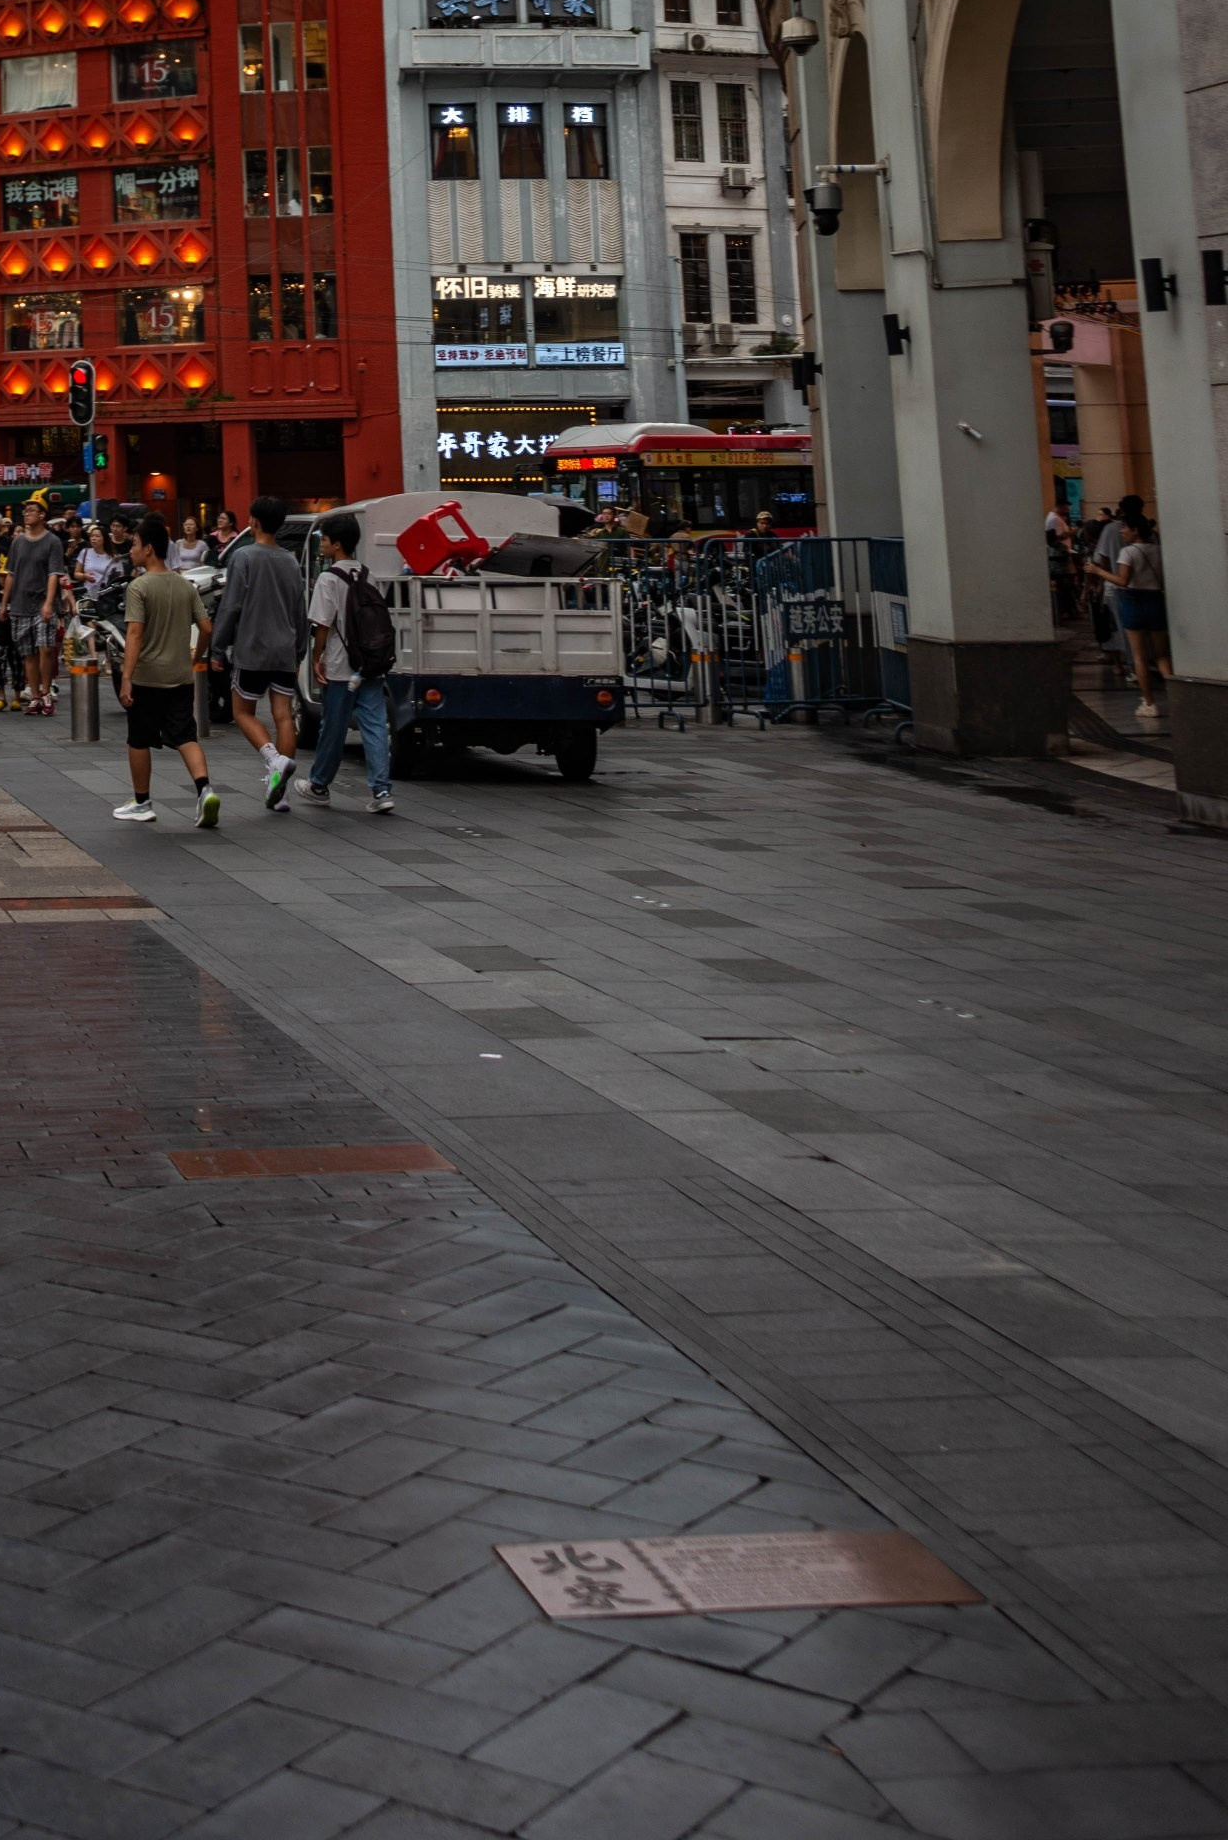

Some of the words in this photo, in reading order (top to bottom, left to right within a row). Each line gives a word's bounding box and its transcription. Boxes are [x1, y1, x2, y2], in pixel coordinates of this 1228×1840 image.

[141, 60, 166, 84] 15
[5, 176, 79, 204] 我会记得
[534, 276, 617, 298] 海鲜研究部
[148, 305, 174, 328] 15
[560, 346, 622, 363] 上榜餐厅
[788, 604, 844, 634] 越秀公安
